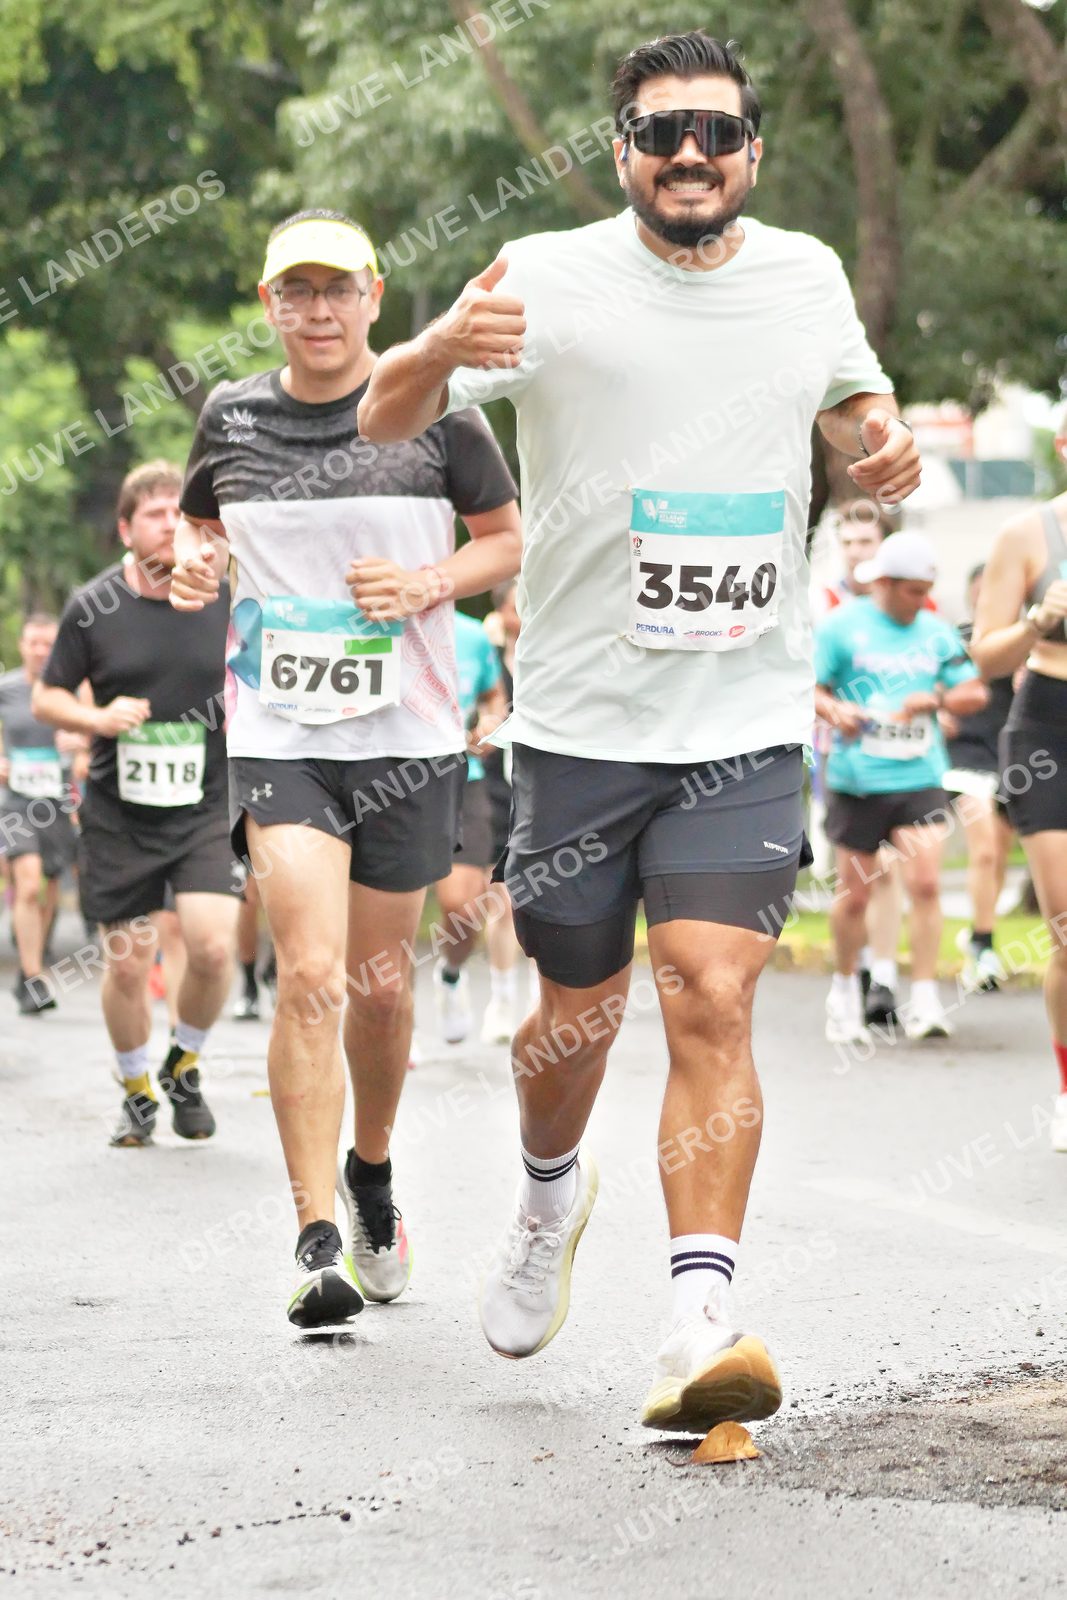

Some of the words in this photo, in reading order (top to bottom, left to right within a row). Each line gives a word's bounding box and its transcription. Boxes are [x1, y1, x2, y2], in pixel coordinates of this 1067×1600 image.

[637, 562, 777, 612] 3540
[636, 623, 675, 635] PERDURA
[271, 654, 383, 695] 6761
[126, 760, 196, 784] 2118
